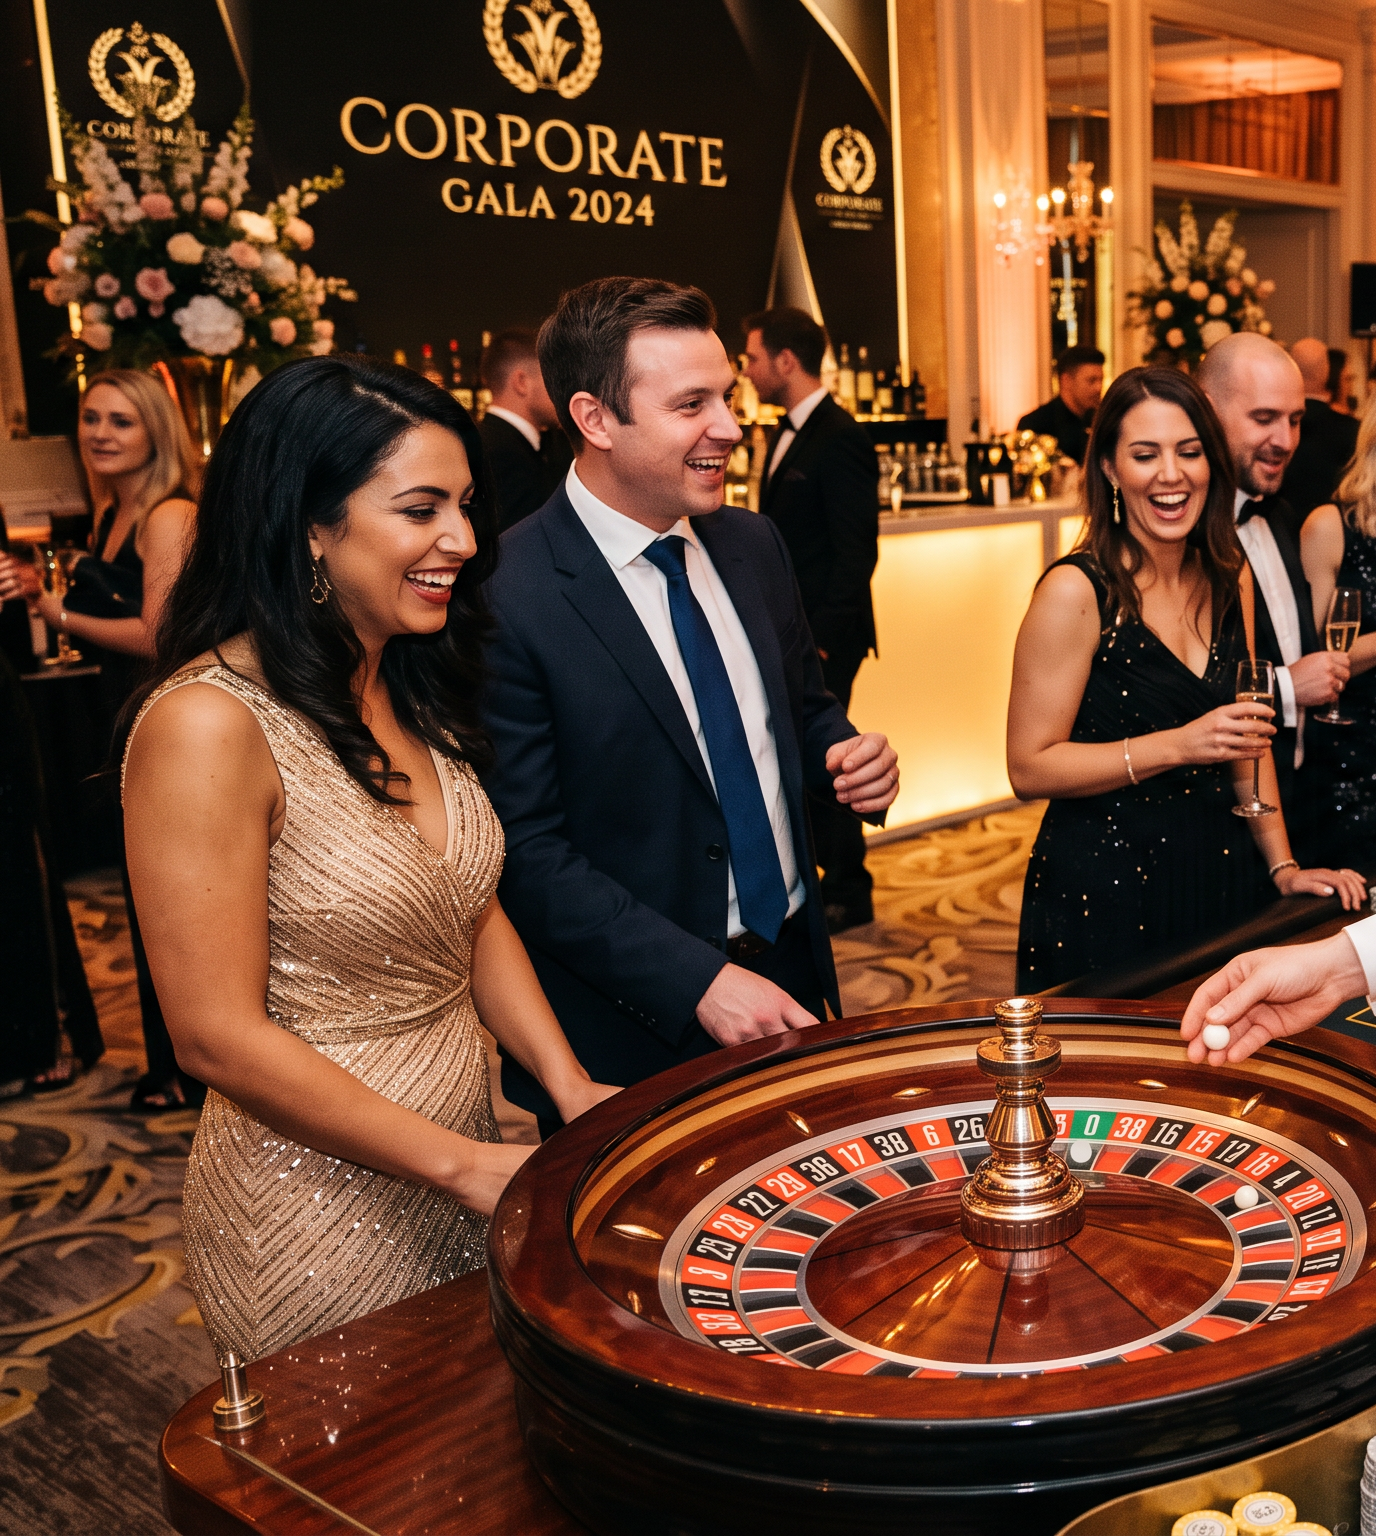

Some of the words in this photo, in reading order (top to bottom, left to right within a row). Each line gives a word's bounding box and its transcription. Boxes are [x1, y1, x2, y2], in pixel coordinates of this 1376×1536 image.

[339, 96, 728, 188] CORPORATE
[441, 177, 556, 220] GALA
[568, 187, 655, 227] 2024
[921, 1124, 940, 1146] 6
[955, 1117, 985, 1141] 26
[1083, 1114, 1100, 1136] 0
[1114, 1117, 1147, 1139] 38
[1150, 1121, 1183, 1145] 16
[873, 1131, 909, 1157] 38
[1186, 1130, 1221, 1153] 15
[837, 1142, 867, 1168] 17
[1243, 1152, 1279, 1176] 16
[800, 1156, 839, 1183] 36
[1273, 1170, 1301, 1189] 4
[766, 1171, 807, 1198] 29
[1285, 1184, 1325, 1209] 20
[738, 1191, 780, 1216] 22
[712, 1213, 755, 1238] 28
